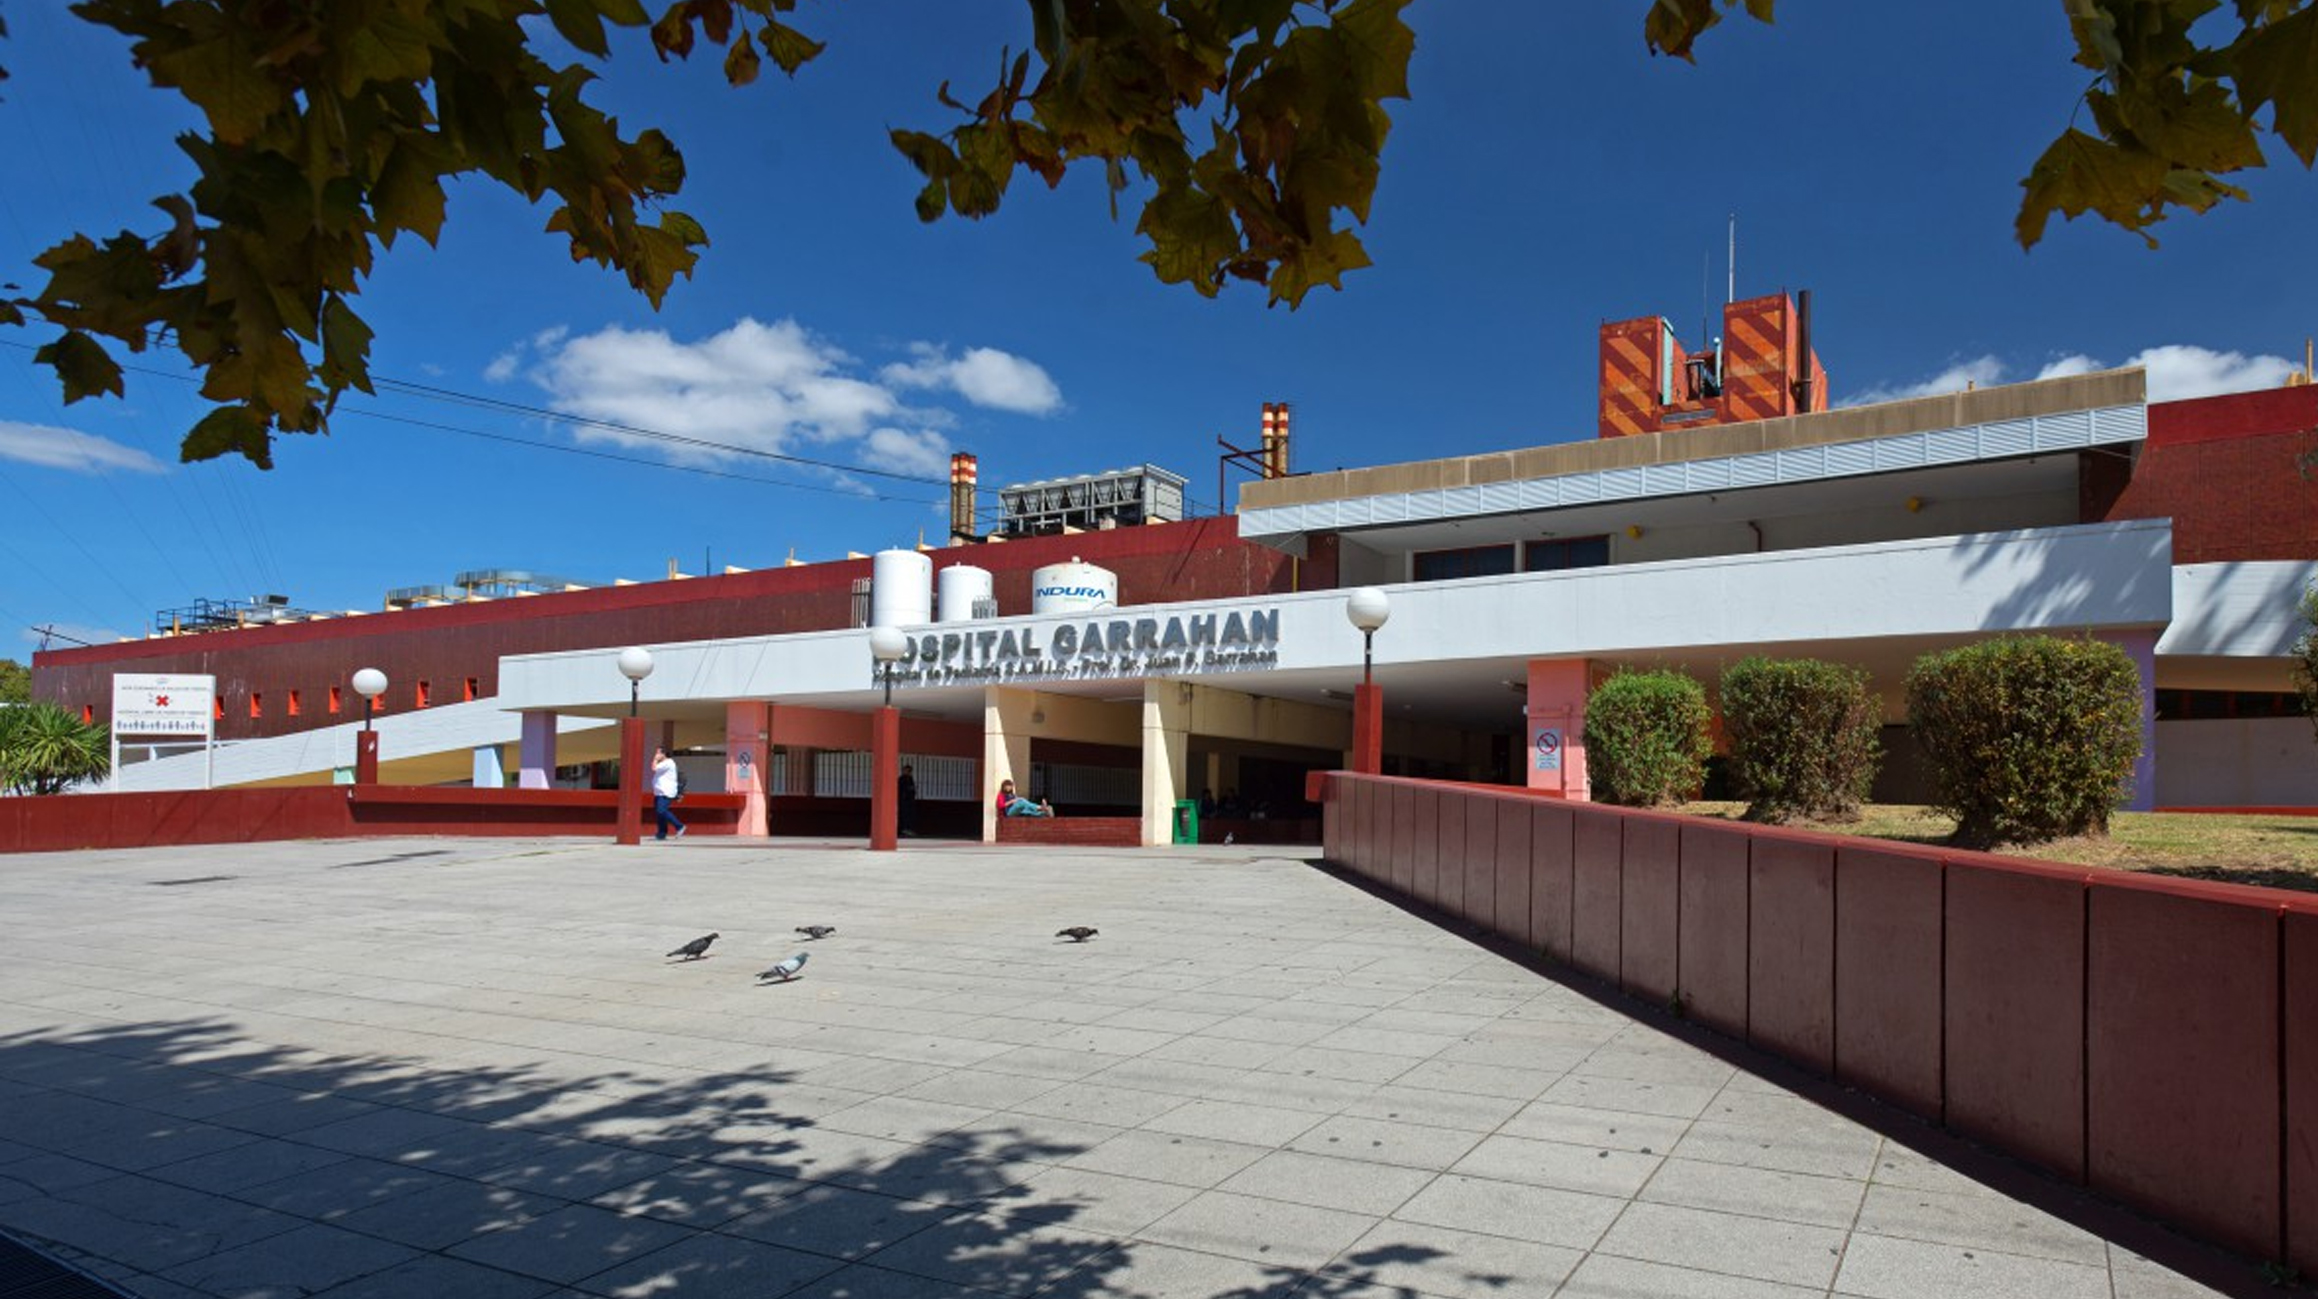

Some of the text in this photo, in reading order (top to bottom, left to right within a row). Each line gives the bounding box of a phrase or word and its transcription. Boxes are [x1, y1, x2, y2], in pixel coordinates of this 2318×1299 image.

[873, 608, 1279, 665] OSPITAL GARRAHAN
[1145, 653, 1180, 669] Juan
[1204, 647, 1278, 666] Garrahan
